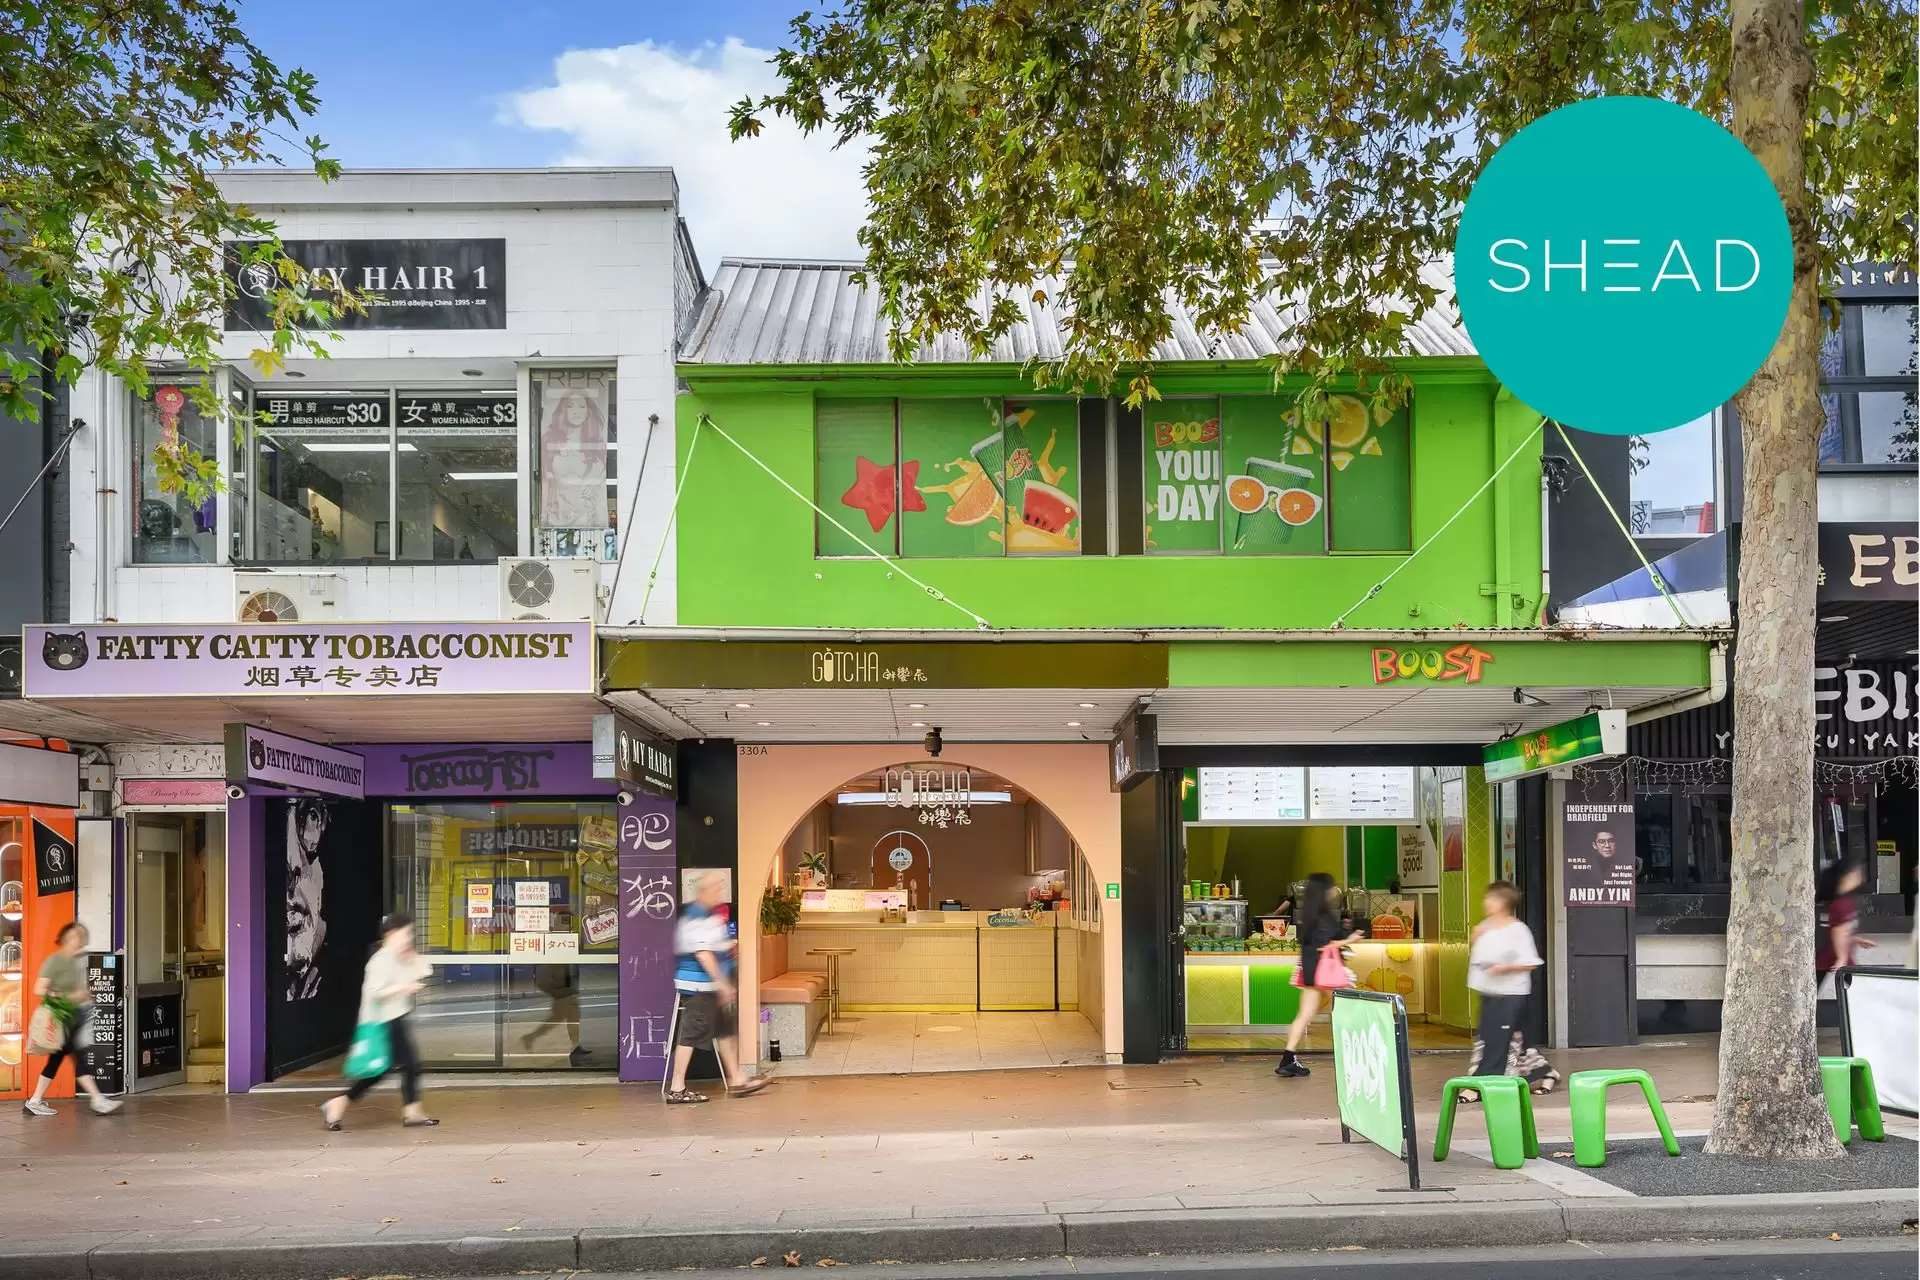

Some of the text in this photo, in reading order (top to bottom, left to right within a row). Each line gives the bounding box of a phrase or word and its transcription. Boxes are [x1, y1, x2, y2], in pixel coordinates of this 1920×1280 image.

[362, 266, 456, 290] HAIR
[473, 266, 488, 289] 1
[270, 400, 289, 423] 男
[293, 416, 346, 424] MENS HAIRCUT
[347, 403, 381, 425] $30
[402, 400, 427, 423] 女
[432, 416, 490, 424] WOMEN HAIRCUT
[493, 403, 517, 424] $3
[1157, 484, 1219, 521] DAY
[97, 633, 573, 660] FATTY CATTY TOBACCONIST
[812, 648, 879, 682] GOTCHA
[1371, 643, 1494, 684] BOOST
[244, 664, 443, 687] 烟草专卖店
[1814, 667, 1919, 722] EBI
[266, 747, 362, 785] FATTY CATTY TOBACCONIST
[632, 738, 672, 778] MY HAIR 1
[885, 770, 970, 808] GOTCHA
[1566, 804, 1634, 813] INDEPENDENT FOR
[1567, 813, 1608, 821] BRADFIELD
[1877, 842, 1895, 850] LOSED
[40, 879, 51, 888] MY
[53, 875, 71, 886] HAIR
[472, 888, 488, 896] SALE
[1569, 888, 1631, 901] ANDY YIN
[590, 917, 616, 936] RAW
[514, 938, 541, 952] 담배
[89, 968, 102, 981] 男
[96, 993, 115, 1003] $30
[88, 1006, 102, 1020] 女
[95, 1031, 115, 1042] $30
[142, 1031, 151, 1040] MY
[153, 1028, 170, 1038] HAIR
[1340, 1021, 1388, 1112] BOOST
